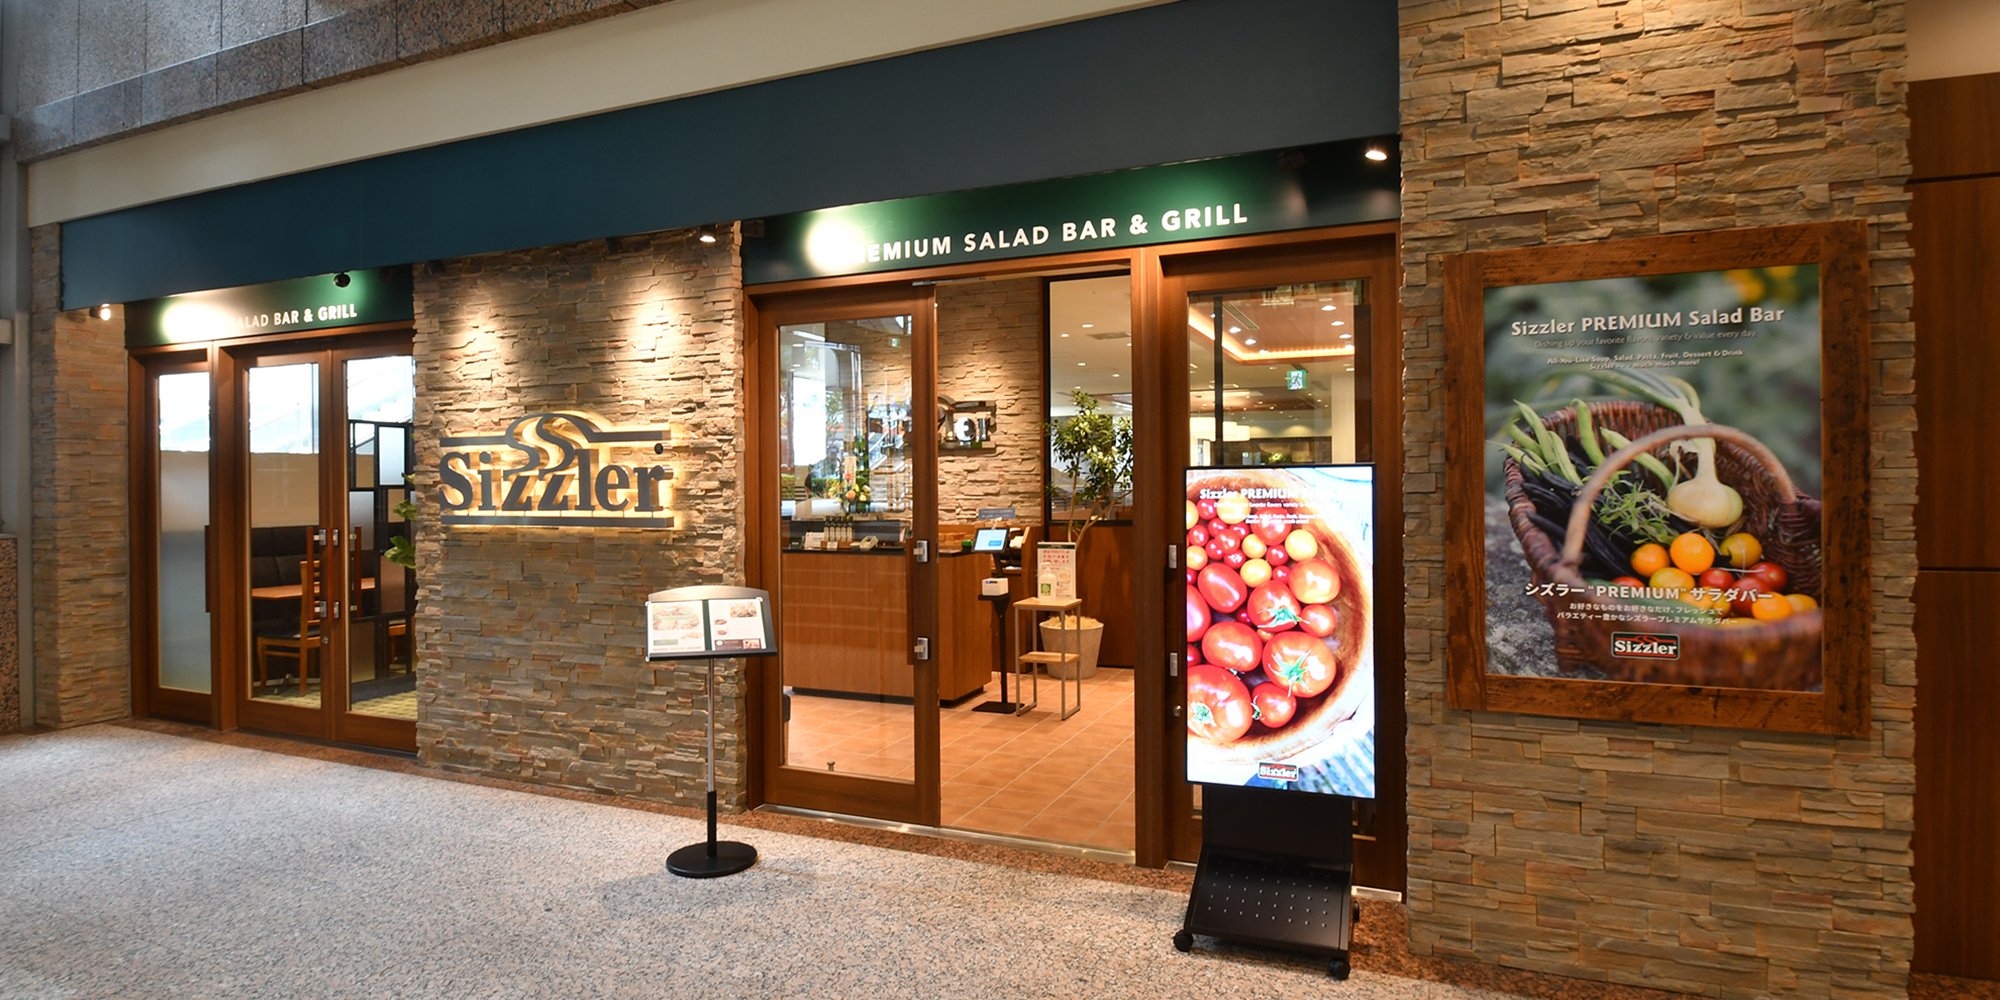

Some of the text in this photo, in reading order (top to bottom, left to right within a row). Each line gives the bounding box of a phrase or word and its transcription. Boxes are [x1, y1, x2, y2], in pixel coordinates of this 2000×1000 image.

[963, 224, 1050, 253] SALAD
[1062, 217, 1117, 242] BAR
[1129, 214, 1149, 236] &
[1161, 203, 1248, 232] GRILL
[233, 303, 358, 329] ALAD BAR & GRILL
[1511, 306, 1785, 336] Sizzler PREMIUM Salad Bar
[1595, 335, 1625, 346] favorite
[1717, 329, 1740, 340] every
[1682, 350, 1712, 359] Dessert
[439, 436, 666, 513] Sizzler
[1525, 582, 1586, 597] シズラー
[1690, 588, 1773, 602] サラダバー
[1613, 639, 1678, 655] Sizzler
